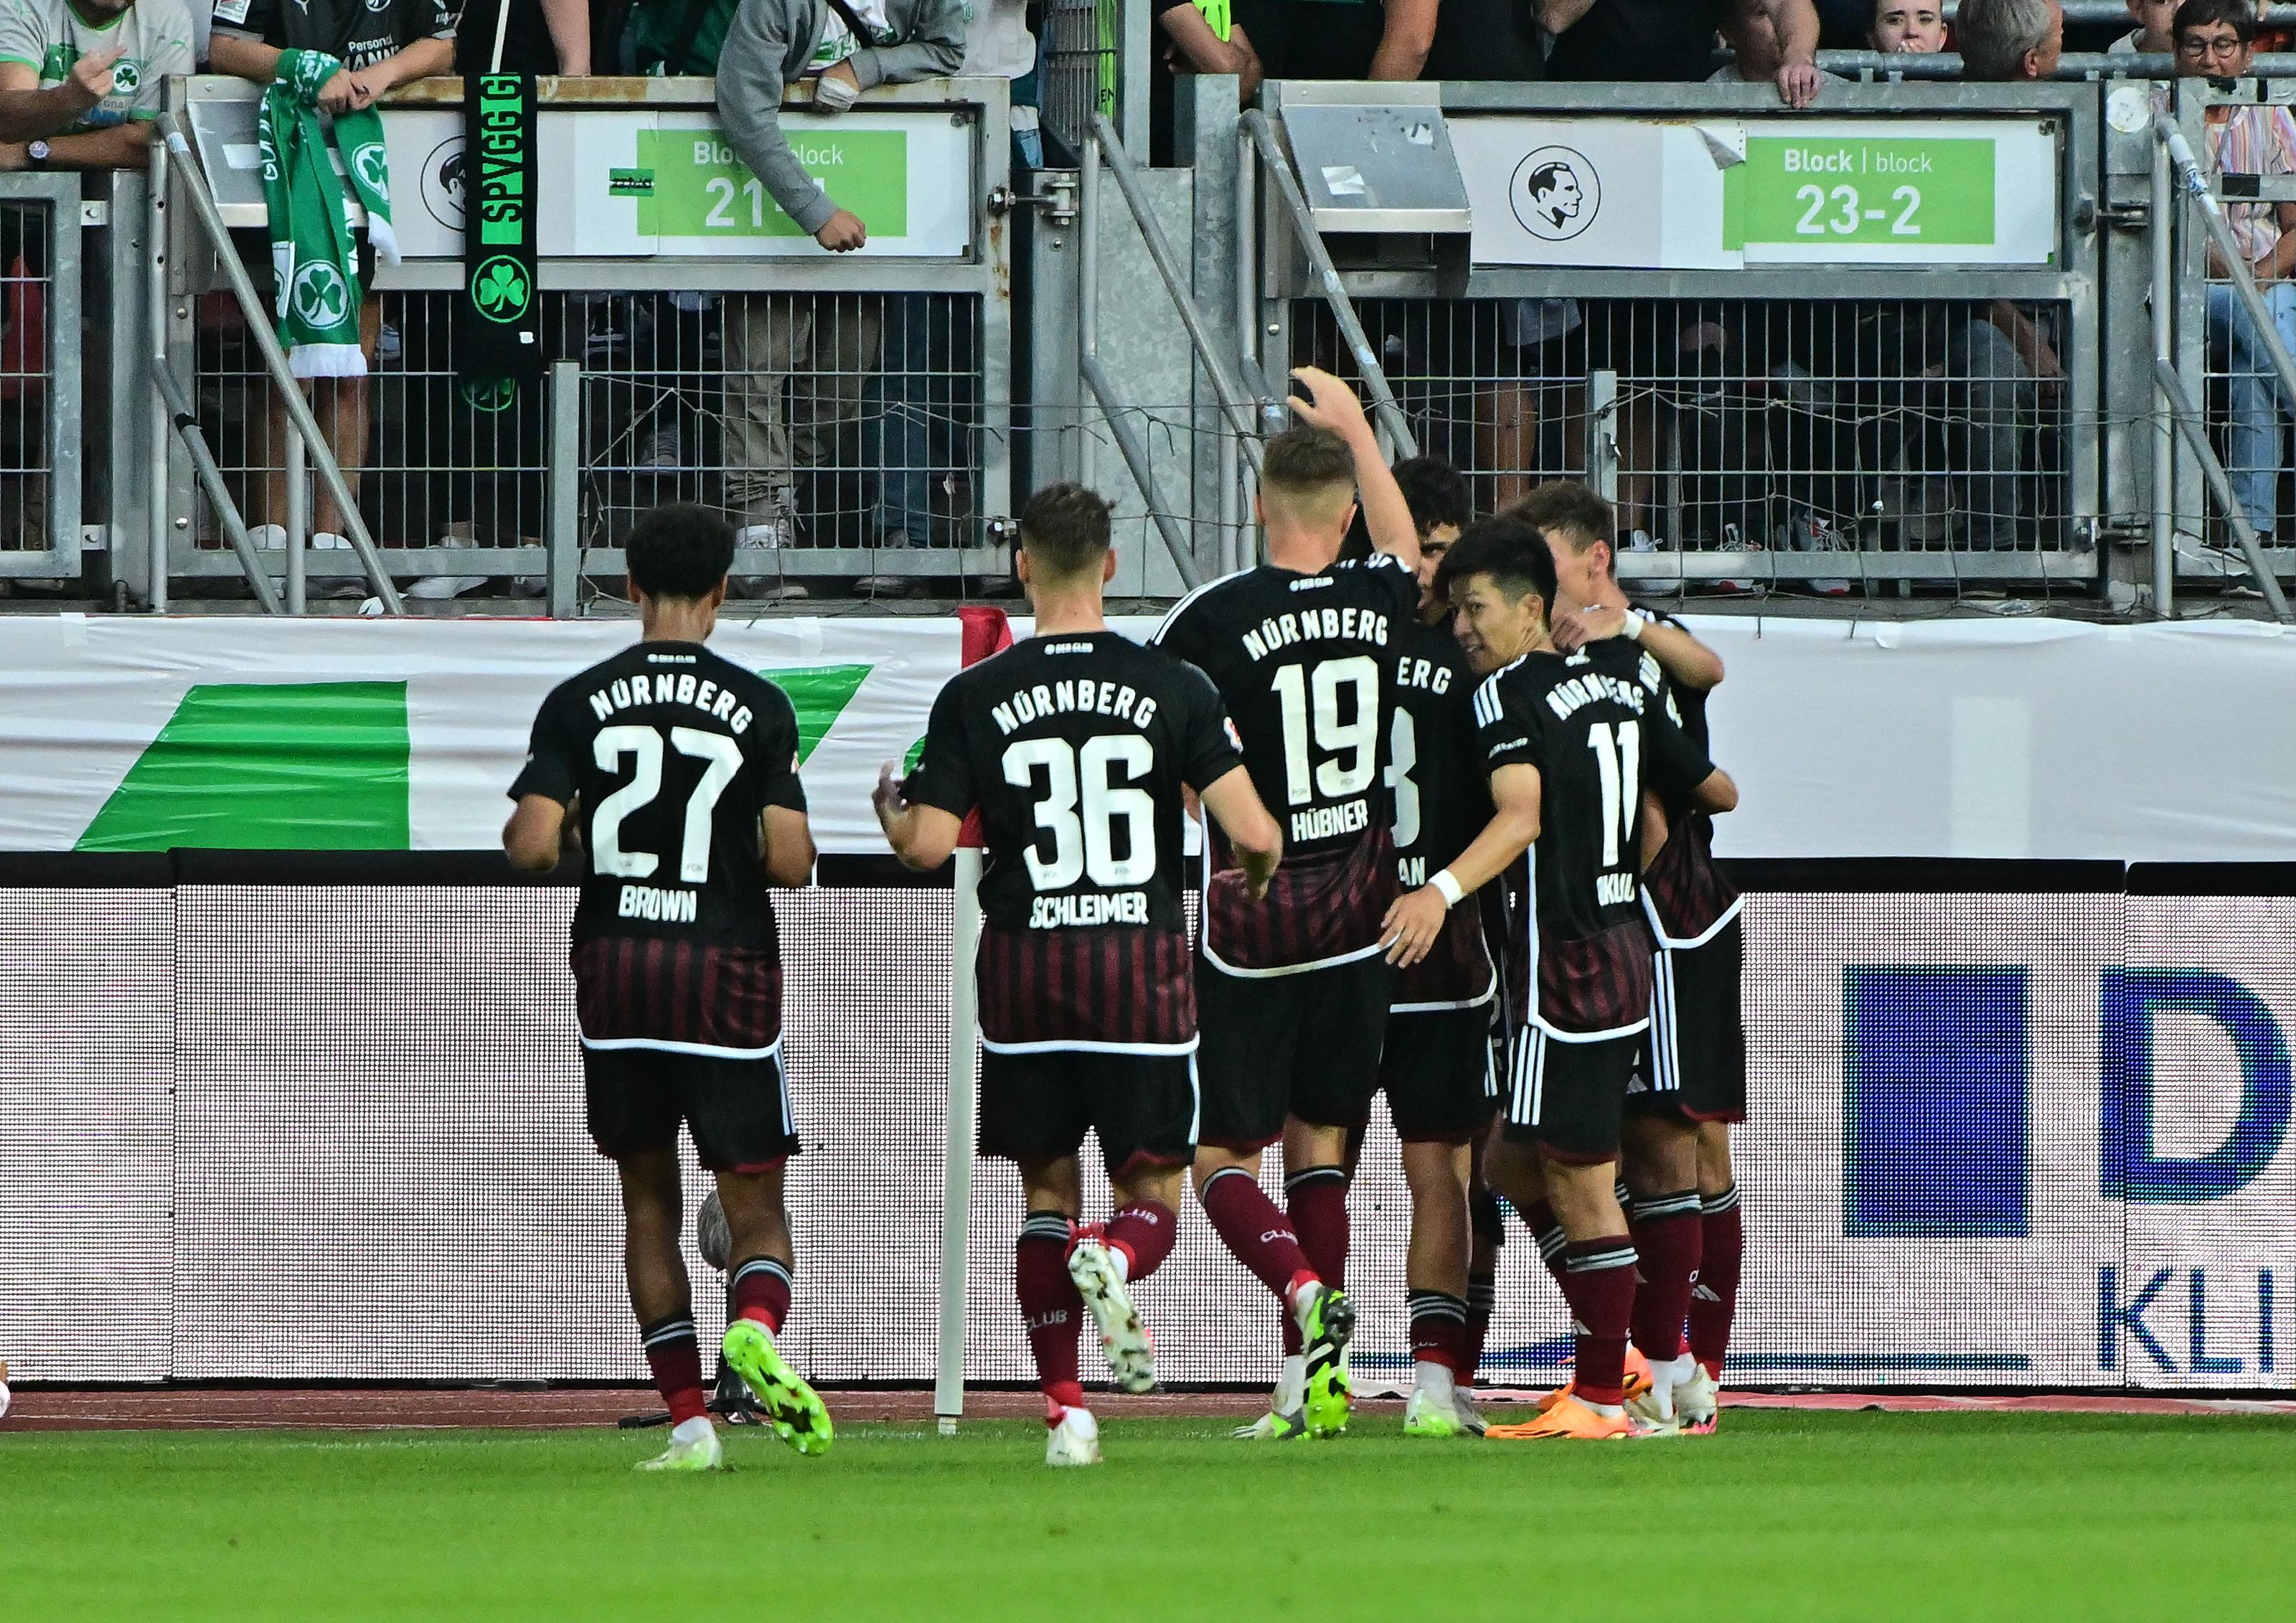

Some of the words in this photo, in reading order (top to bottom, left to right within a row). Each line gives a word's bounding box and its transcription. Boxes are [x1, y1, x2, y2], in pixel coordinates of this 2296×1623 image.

[481, 110, 523, 224] SPVGG
[694, 141, 743, 165] Blo
[1784, 149, 1854, 173] Block
[1876, 151, 1932, 173] block
[705, 177, 824, 227] 21-
[1796, 184, 1921, 234] 23-2
[1242, 608, 1388, 662] NÜRNBERG
[1396, 656, 1452, 695] ERG
[589, 674, 753, 735] NÜRNBERG
[991, 679, 1157, 735] NÜRNBERG
[1271, 655, 1378, 806] 19
[591, 725, 744, 883] 27
[1002, 734, 1156, 891] 36
[1291, 799, 1368, 842] HÜBNER
[1587, 720, 1640, 867] 11
[1398, 857, 1426, 886] AN
[618, 885, 697, 923] BROWN
[1029, 892, 1149, 930] SCHLEIMER
[2099, 966, 2292, 1205] D
[2098, 1266, 2274, 1373] KLI
